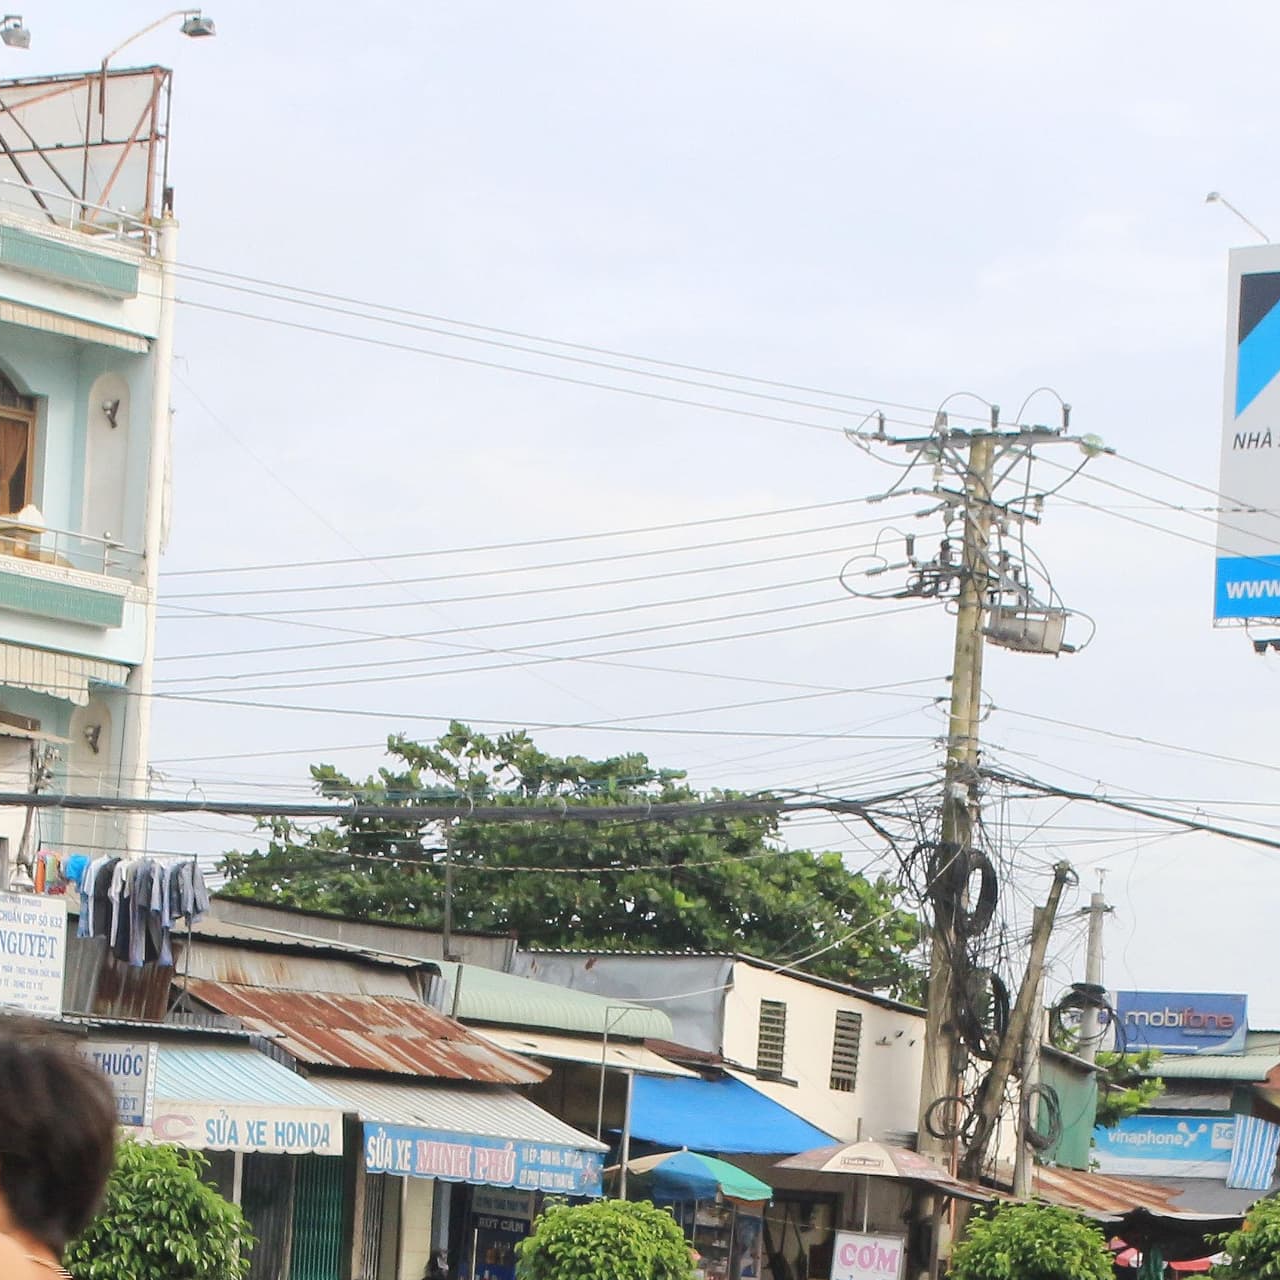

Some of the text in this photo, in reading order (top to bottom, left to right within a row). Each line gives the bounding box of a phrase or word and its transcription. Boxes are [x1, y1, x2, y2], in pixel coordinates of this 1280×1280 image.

[1233, 427, 1272, 450] NHÀ
[1125, 1007, 1234, 1029] mobifone
[93, 1046, 143, 1076] THUỐC
[205, 1109, 330, 1147] SỬA XE HONDA
[1108, 1129, 1183, 1148] vinaphone
[366, 1127, 392, 1169] SỬA
[396, 1138, 412, 1171] XE
[415, 1140, 472, 1178] MINH
[474, 1141, 517, 1184] PHÚ
[840, 1241, 898, 1273] CƠM
